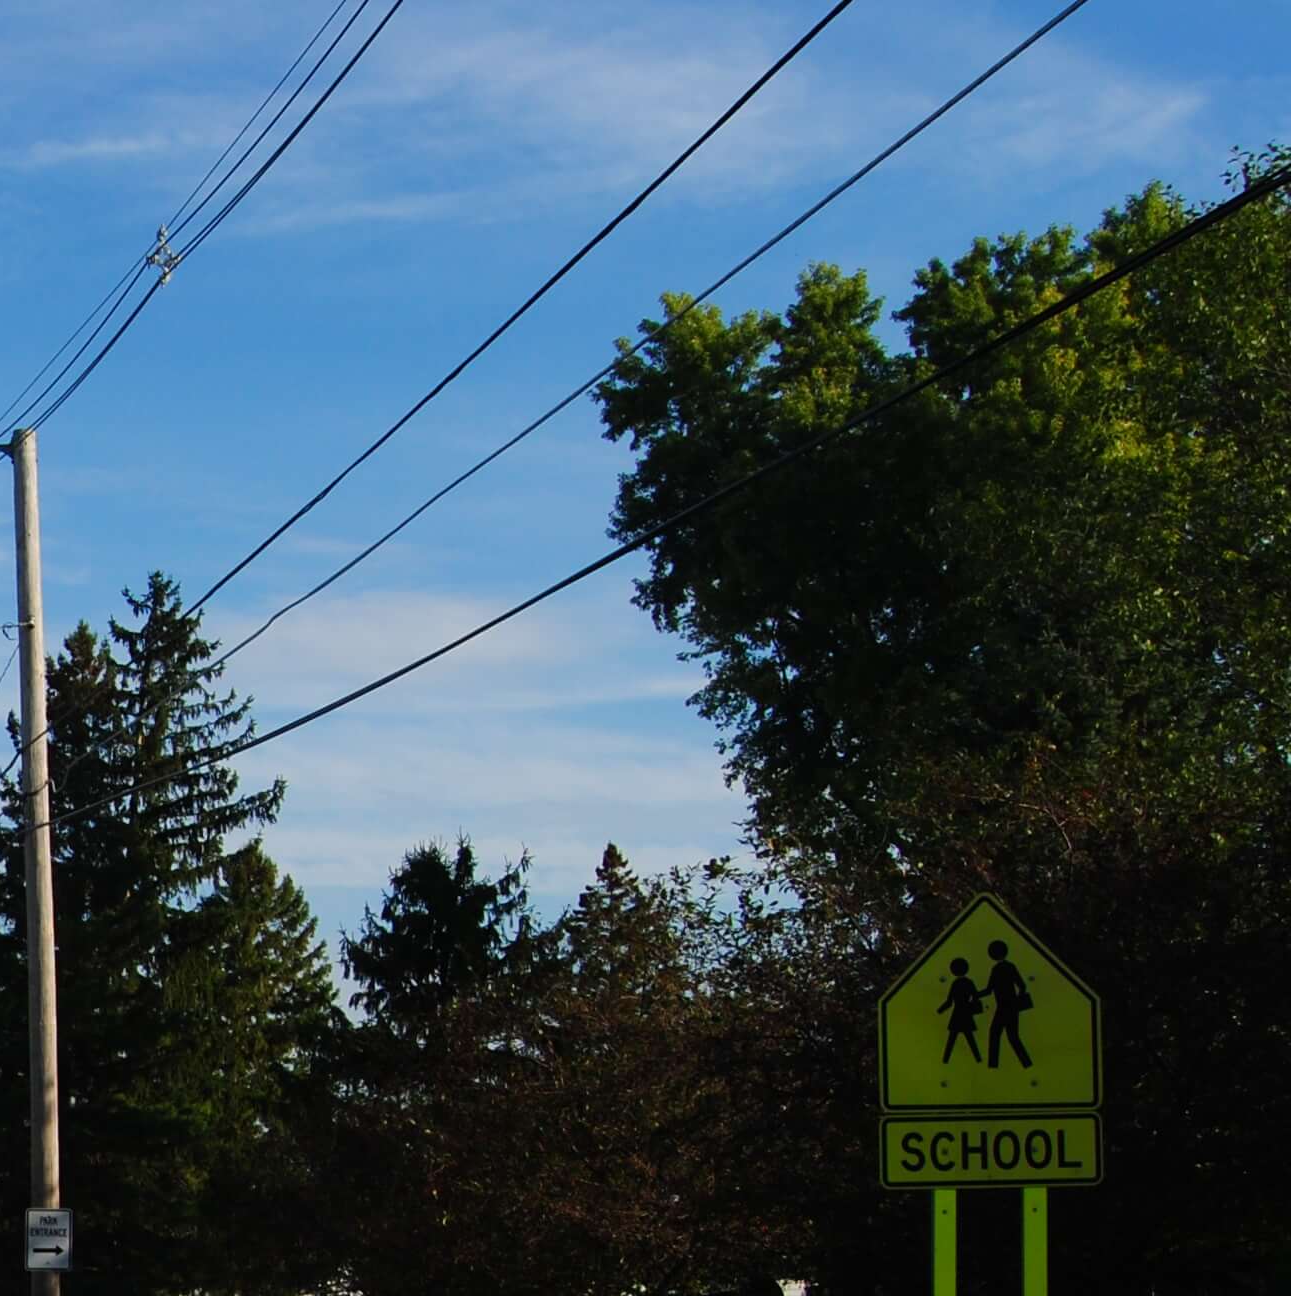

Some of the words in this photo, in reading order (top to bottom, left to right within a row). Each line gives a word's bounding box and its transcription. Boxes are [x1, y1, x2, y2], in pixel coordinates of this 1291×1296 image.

[901, 1130, 1082, 1171] SCHOOL
[40, 1216, 58, 1225] PARK
[30, 1228, 68, 1237] ENTRANCE
